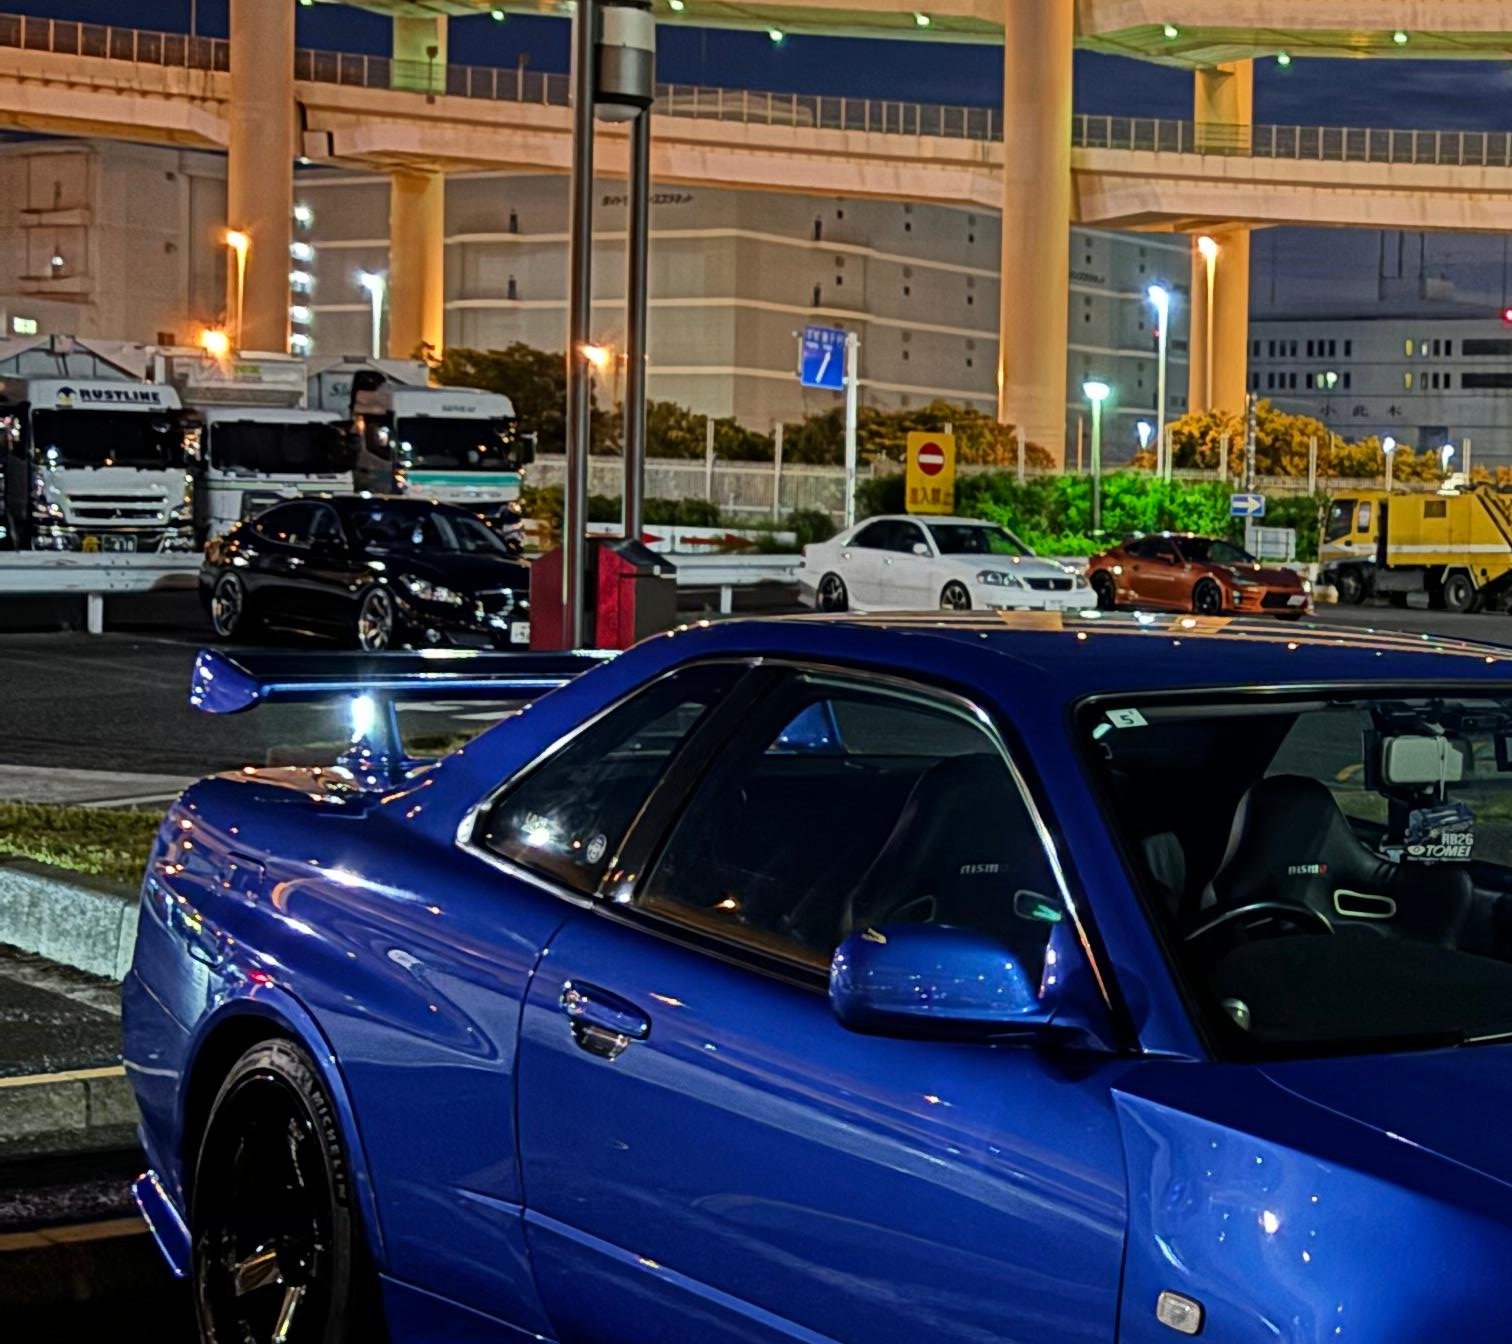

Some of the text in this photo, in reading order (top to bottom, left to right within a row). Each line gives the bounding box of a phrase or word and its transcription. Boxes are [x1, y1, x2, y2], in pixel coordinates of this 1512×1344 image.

[78, 388, 160, 402] RUSTLINE
[1441, 832, 1474, 845] RB26
[1426, 844, 1472, 857] TOMEI
